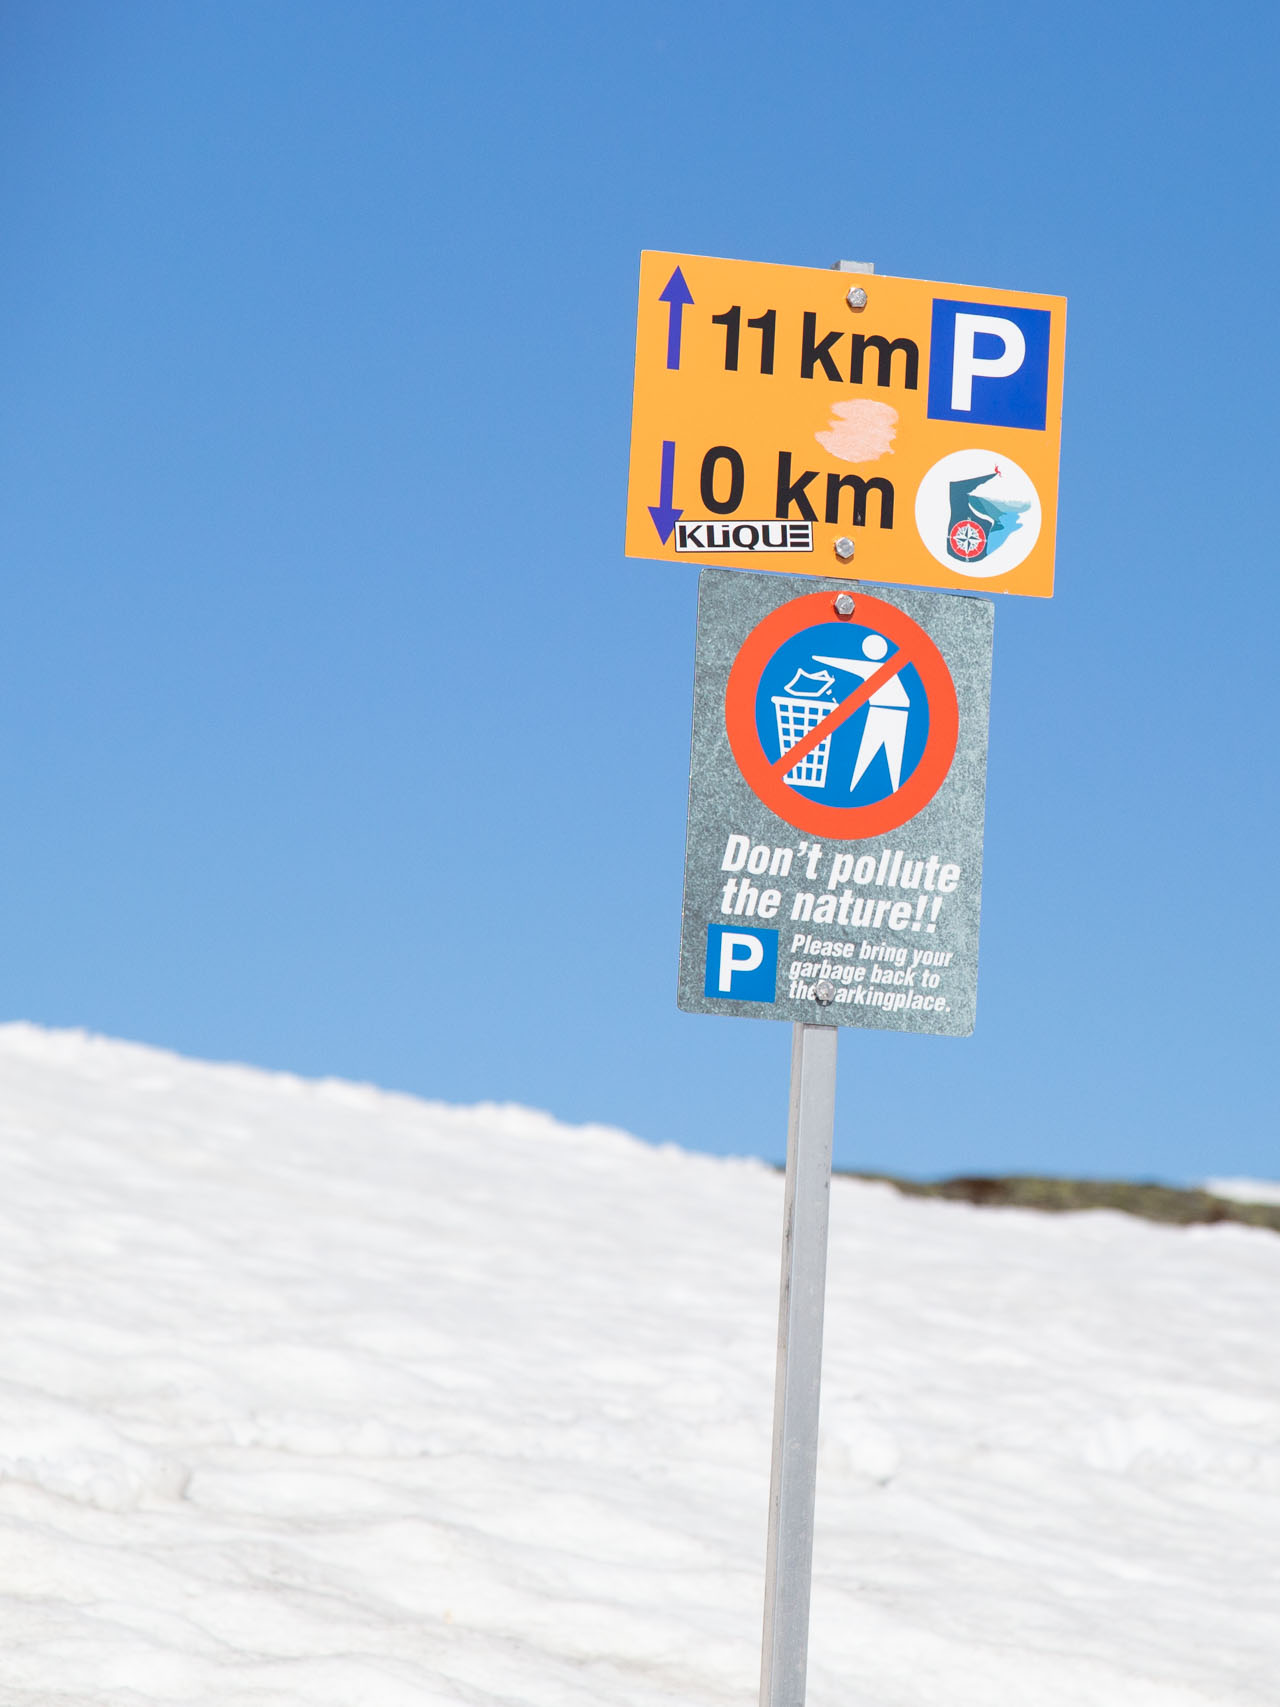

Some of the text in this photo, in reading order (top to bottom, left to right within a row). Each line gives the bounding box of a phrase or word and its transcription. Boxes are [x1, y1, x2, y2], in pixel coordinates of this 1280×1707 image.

[711, 305, 920, 391] 11 km
[950, 312, 1026, 413] P
[699, 445, 895, 530] 0 km
[828, 849, 961, 893] pollute
[721, 879, 944, 934] the nature!!
[718, 931, 764, 993] P
[789, 960, 941, 989] garbage back to
[790, 934, 954, 968] Please bring your
[822, 984, 951, 1013] arkingplace.
